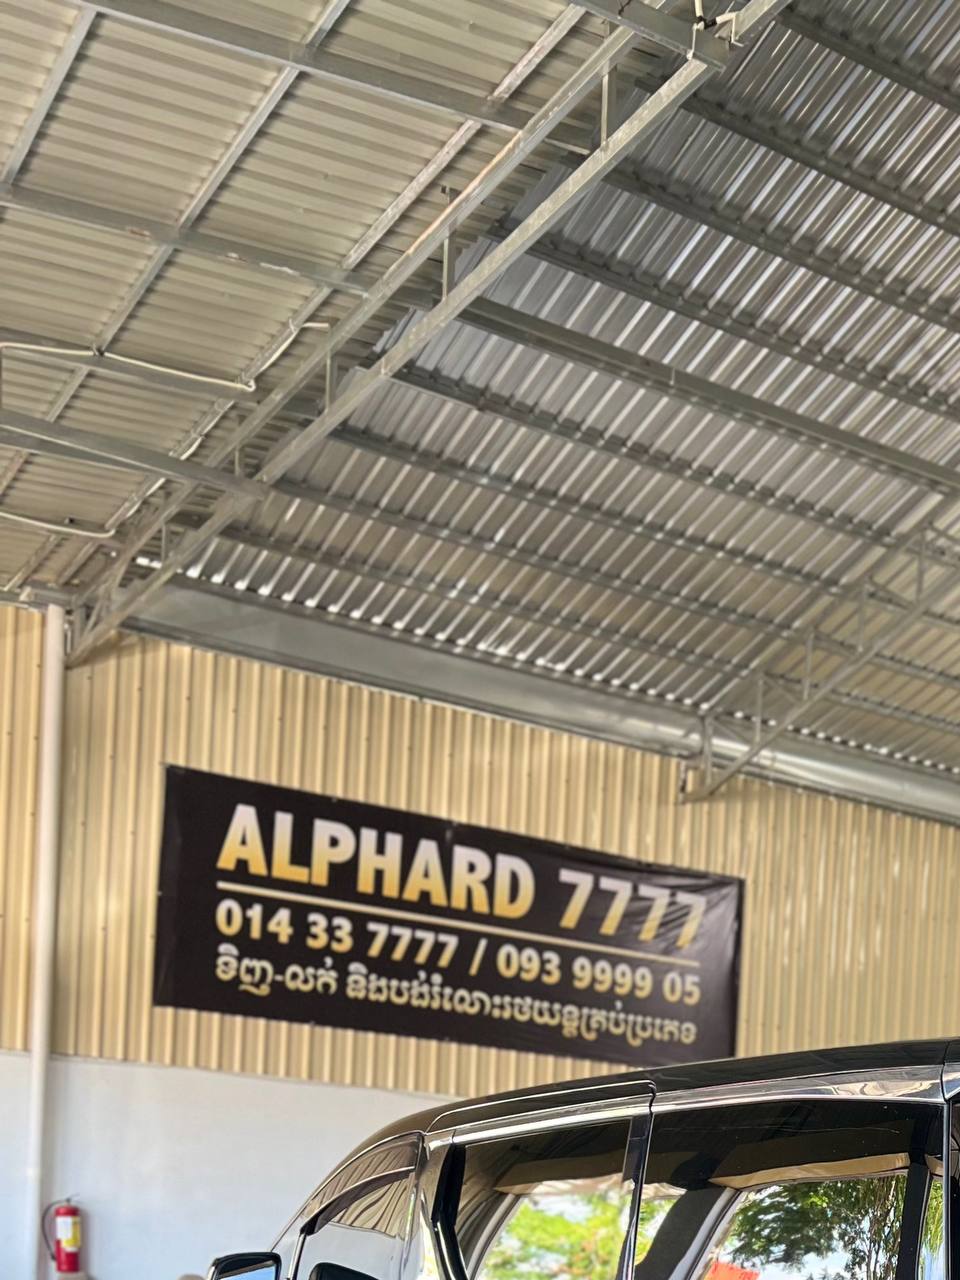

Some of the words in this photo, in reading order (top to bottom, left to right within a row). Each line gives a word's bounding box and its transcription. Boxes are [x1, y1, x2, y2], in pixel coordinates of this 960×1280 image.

[216, 802, 536, 919] ALPHARD
[557, 867, 708, 949] 7777
[215, 899, 293, 944] 014
[306, 912, 354, 953] 33
[366, 921, 459, 969] 7777
[468, 937, 488, 977] /
[496, 943, 562, 985] 093
[572, 956, 653, 999] 9999
[662, 970, 701, 1006] 05
